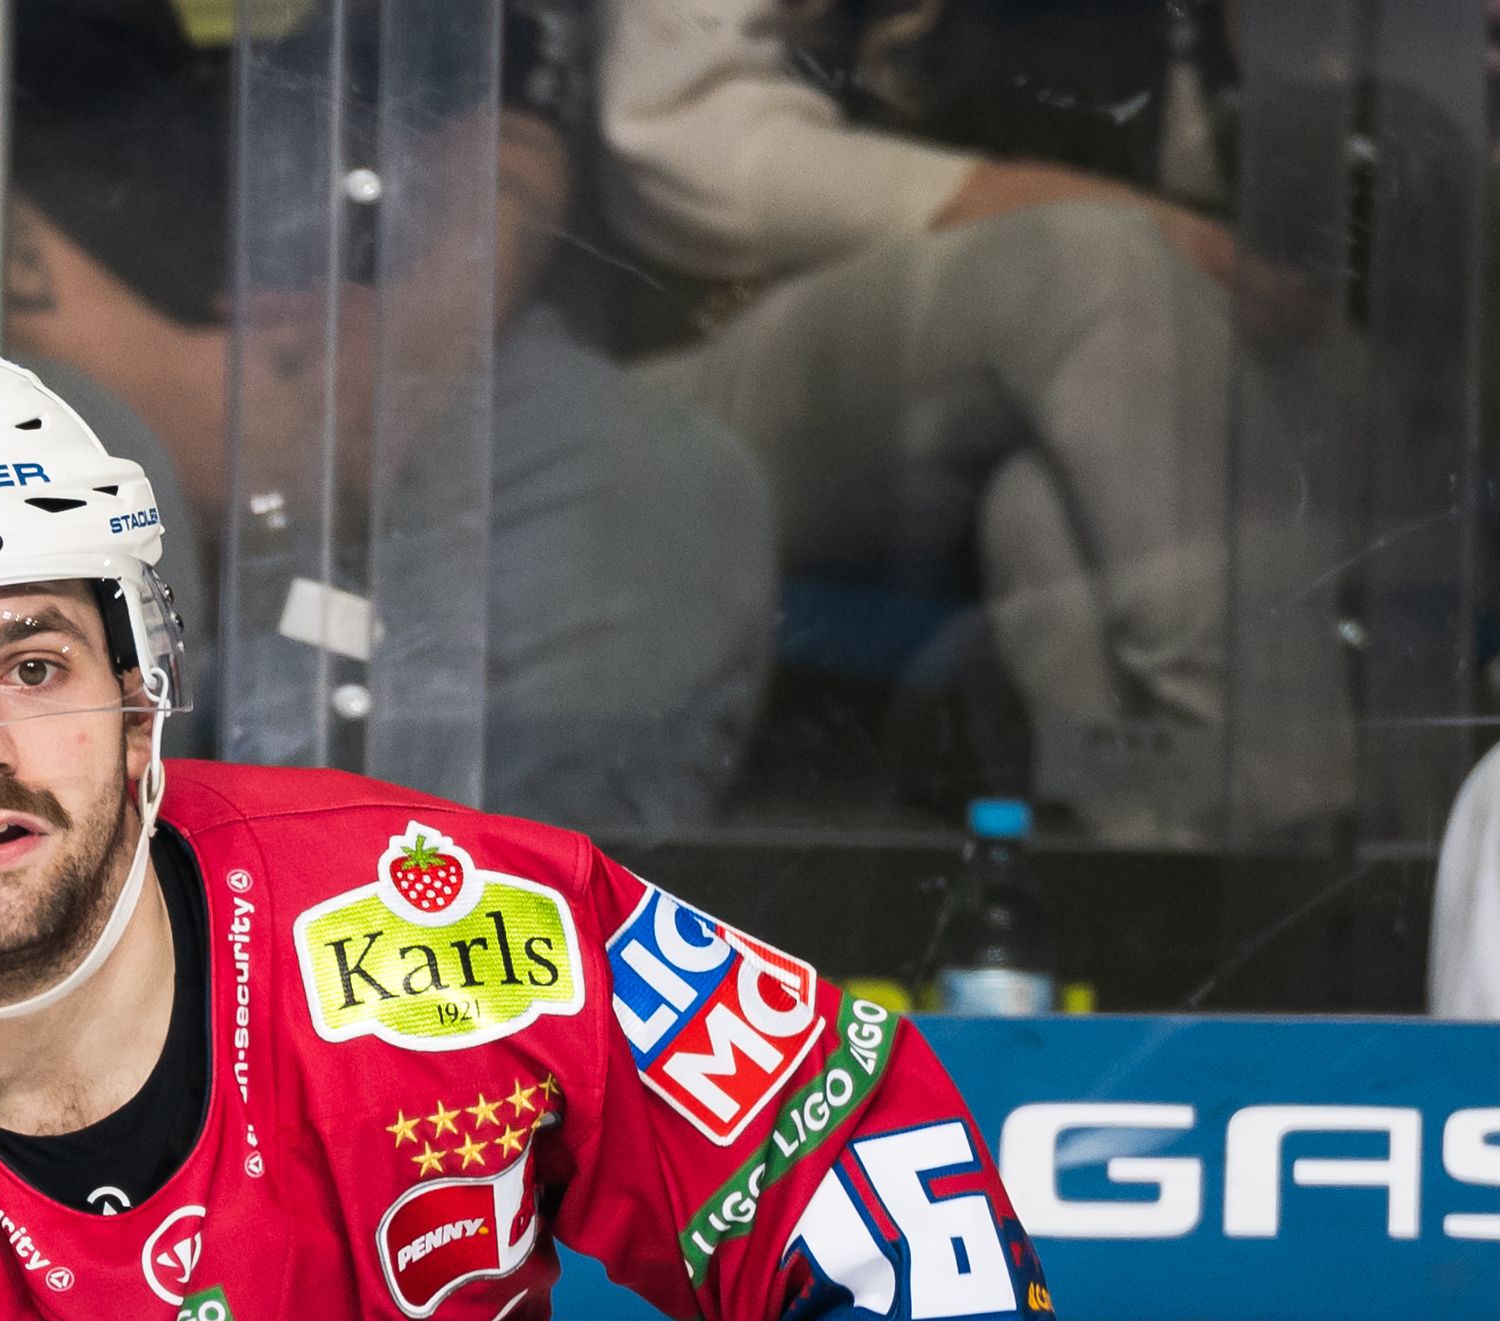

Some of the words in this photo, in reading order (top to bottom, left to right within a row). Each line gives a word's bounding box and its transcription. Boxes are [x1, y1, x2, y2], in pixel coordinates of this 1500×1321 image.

[109, 508, 159, 535] STADLER
[323, 911, 560, 1011] Karls
[436, 1000, 481, 1027] 1921
[773, 1067, 854, 1158] LIGO
[784, 1122, 1018, 1320] 16
